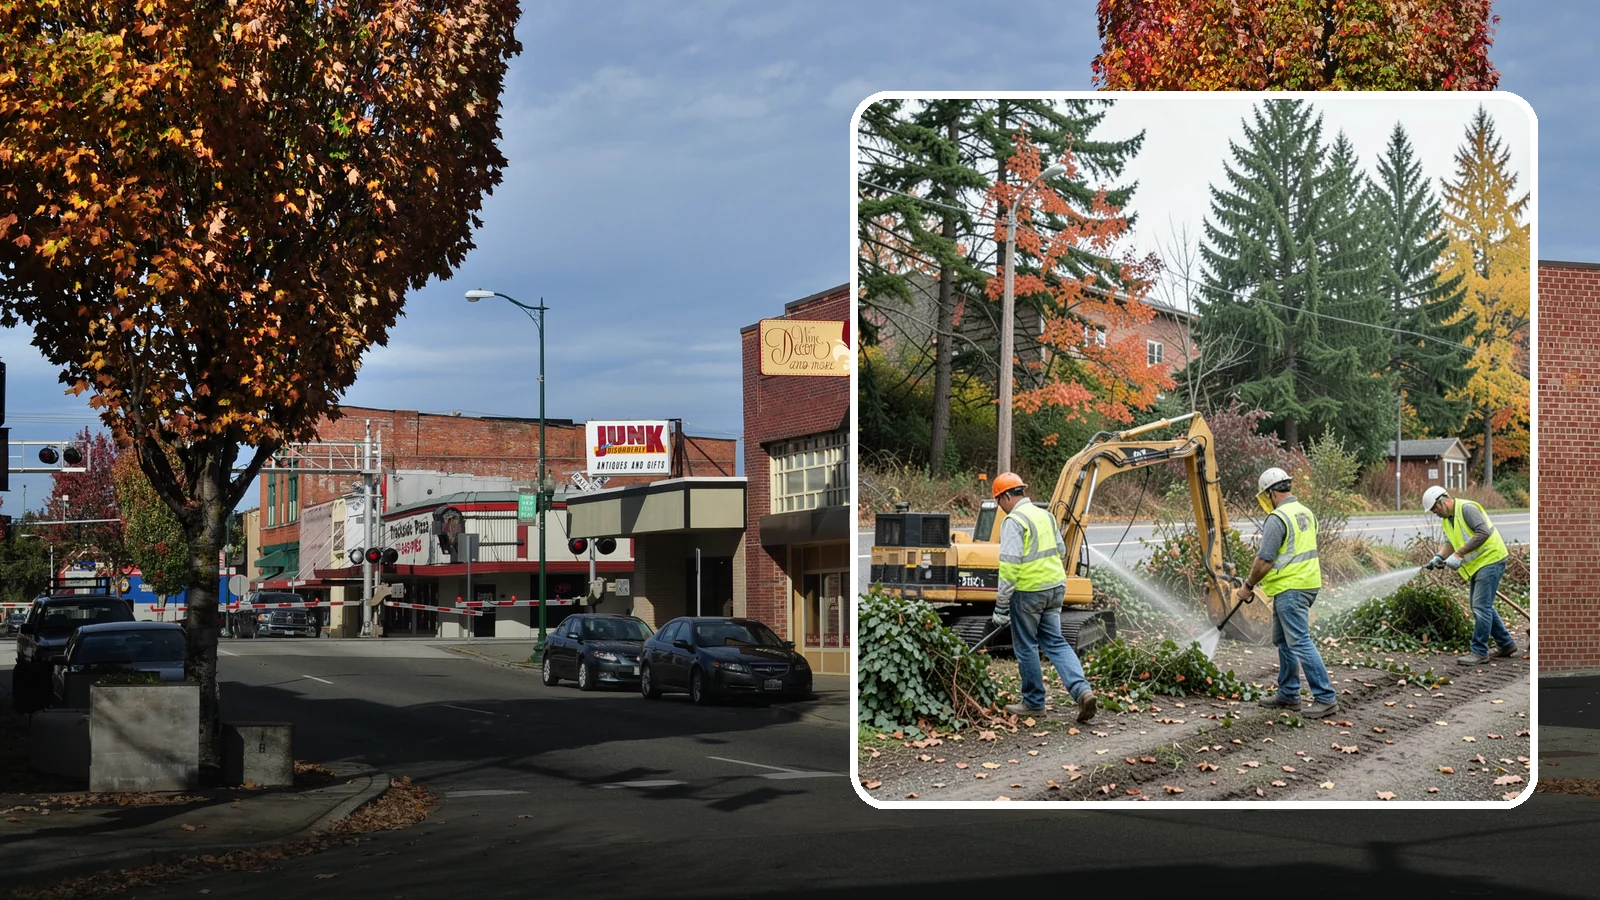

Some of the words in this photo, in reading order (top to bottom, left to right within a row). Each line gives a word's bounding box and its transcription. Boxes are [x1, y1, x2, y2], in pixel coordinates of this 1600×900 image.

[765, 327, 831, 365] Decor
[595, 425, 666, 457] JUNK
[607, 446, 646, 454] DISORDERLY
[597, 461, 628, 470] ANTIQUES
[631, 461, 644, 470] AND
[646, 460, 666, 470] GIFTS
[414, 519, 429, 535] Pizza
